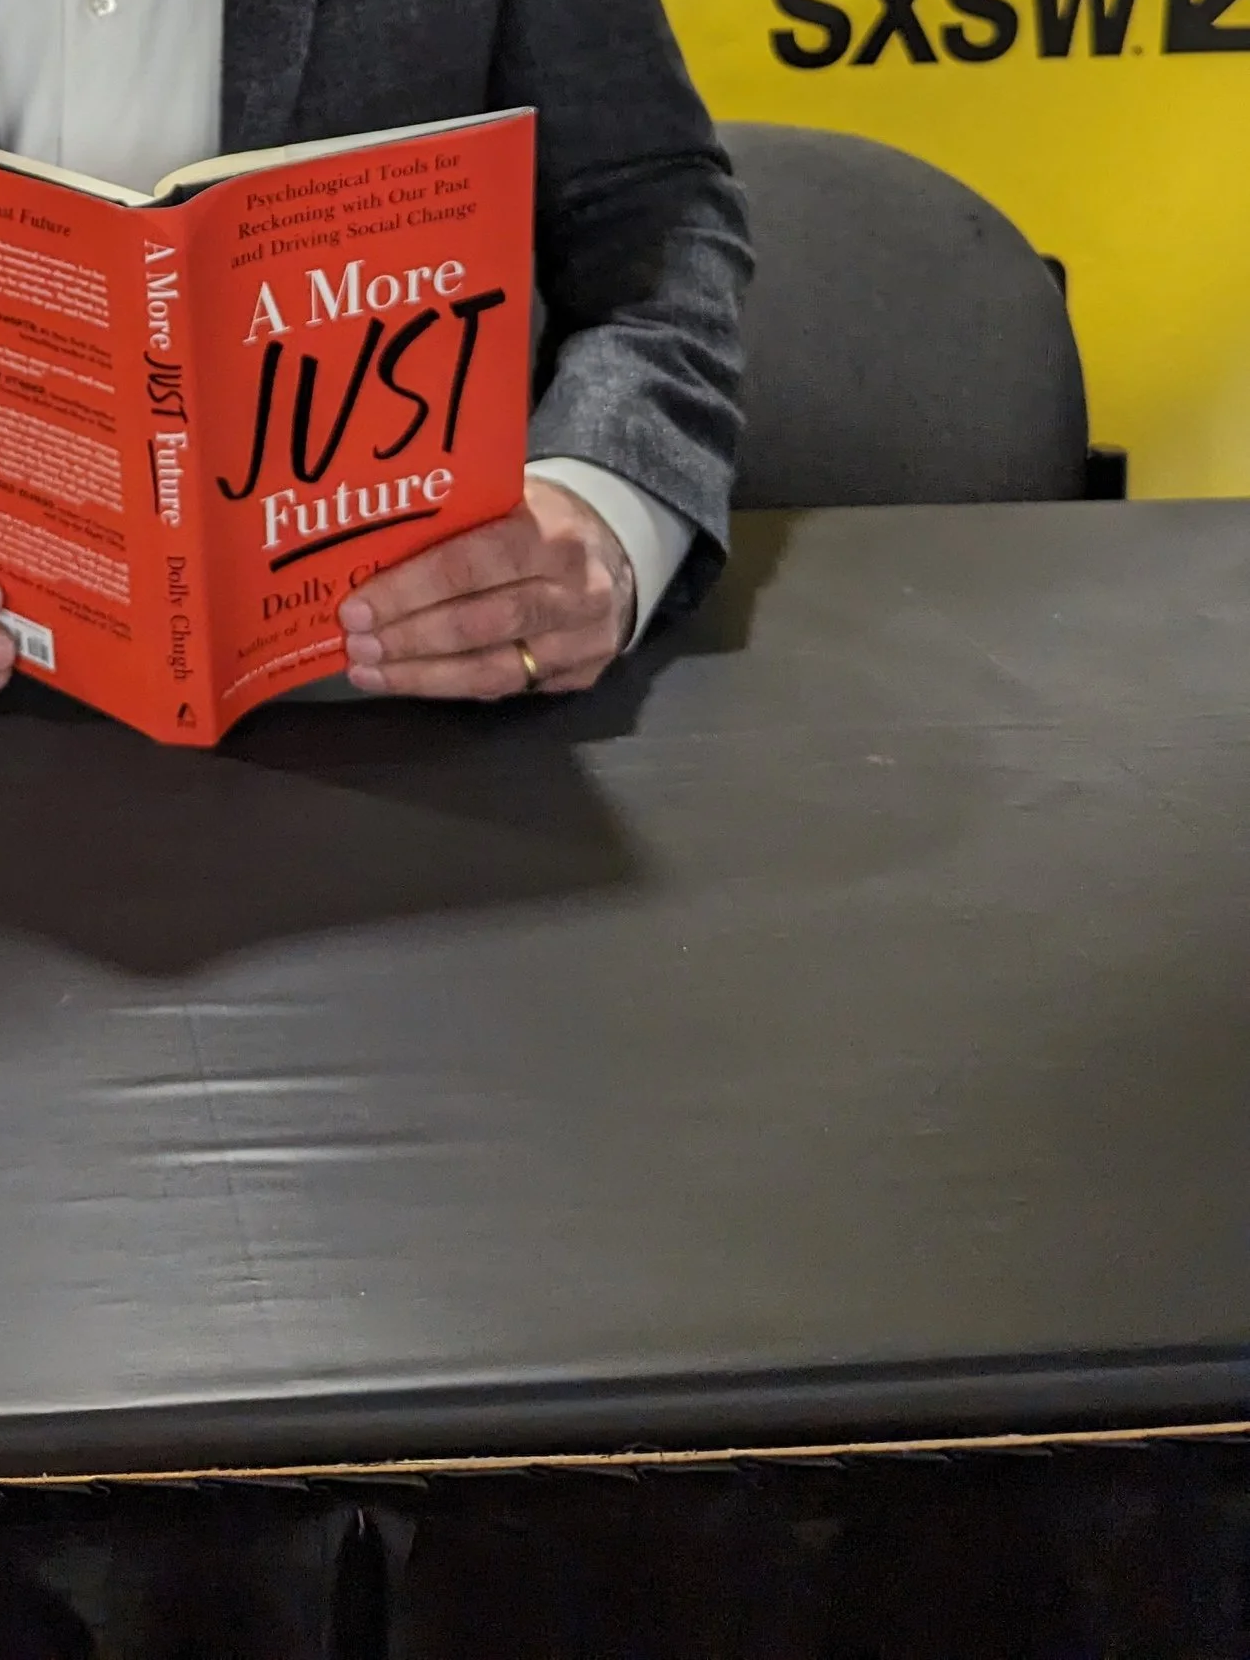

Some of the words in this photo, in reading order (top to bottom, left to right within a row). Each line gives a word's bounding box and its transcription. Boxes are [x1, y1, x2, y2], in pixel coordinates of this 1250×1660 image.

[238, 206, 336, 240] Reckoning
[343, 194, 383, 214] with
[388, 184, 427, 204] Our
[433, 175, 470, 196] Past
[245, 166, 370, 212] Psychological
[377, 161, 429, 183] Tools
[435, 153, 461, 171] for
[19, 208, 72, 238] Future
[143, 239, 176, 264] A
[230, 245, 265, 270] and
[270, 229, 341, 258] Driving
[346, 216, 401, 239] Social
[406, 199, 477, 226] Change
[145, 272, 181, 352] More
[242, 280, 293, 346] A
[305, 259, 467, 328] More
[144, 350, 190, 424] JUST
[216, 287, 506, 500] JUST
[155, 431, 188, 528] Future
[260, 467, 454, 551] Future
[166, 555, 190, 609] Dolly
[262, 577, 337, 621] Dolly
[167, 615, 193, 682] Chugh
